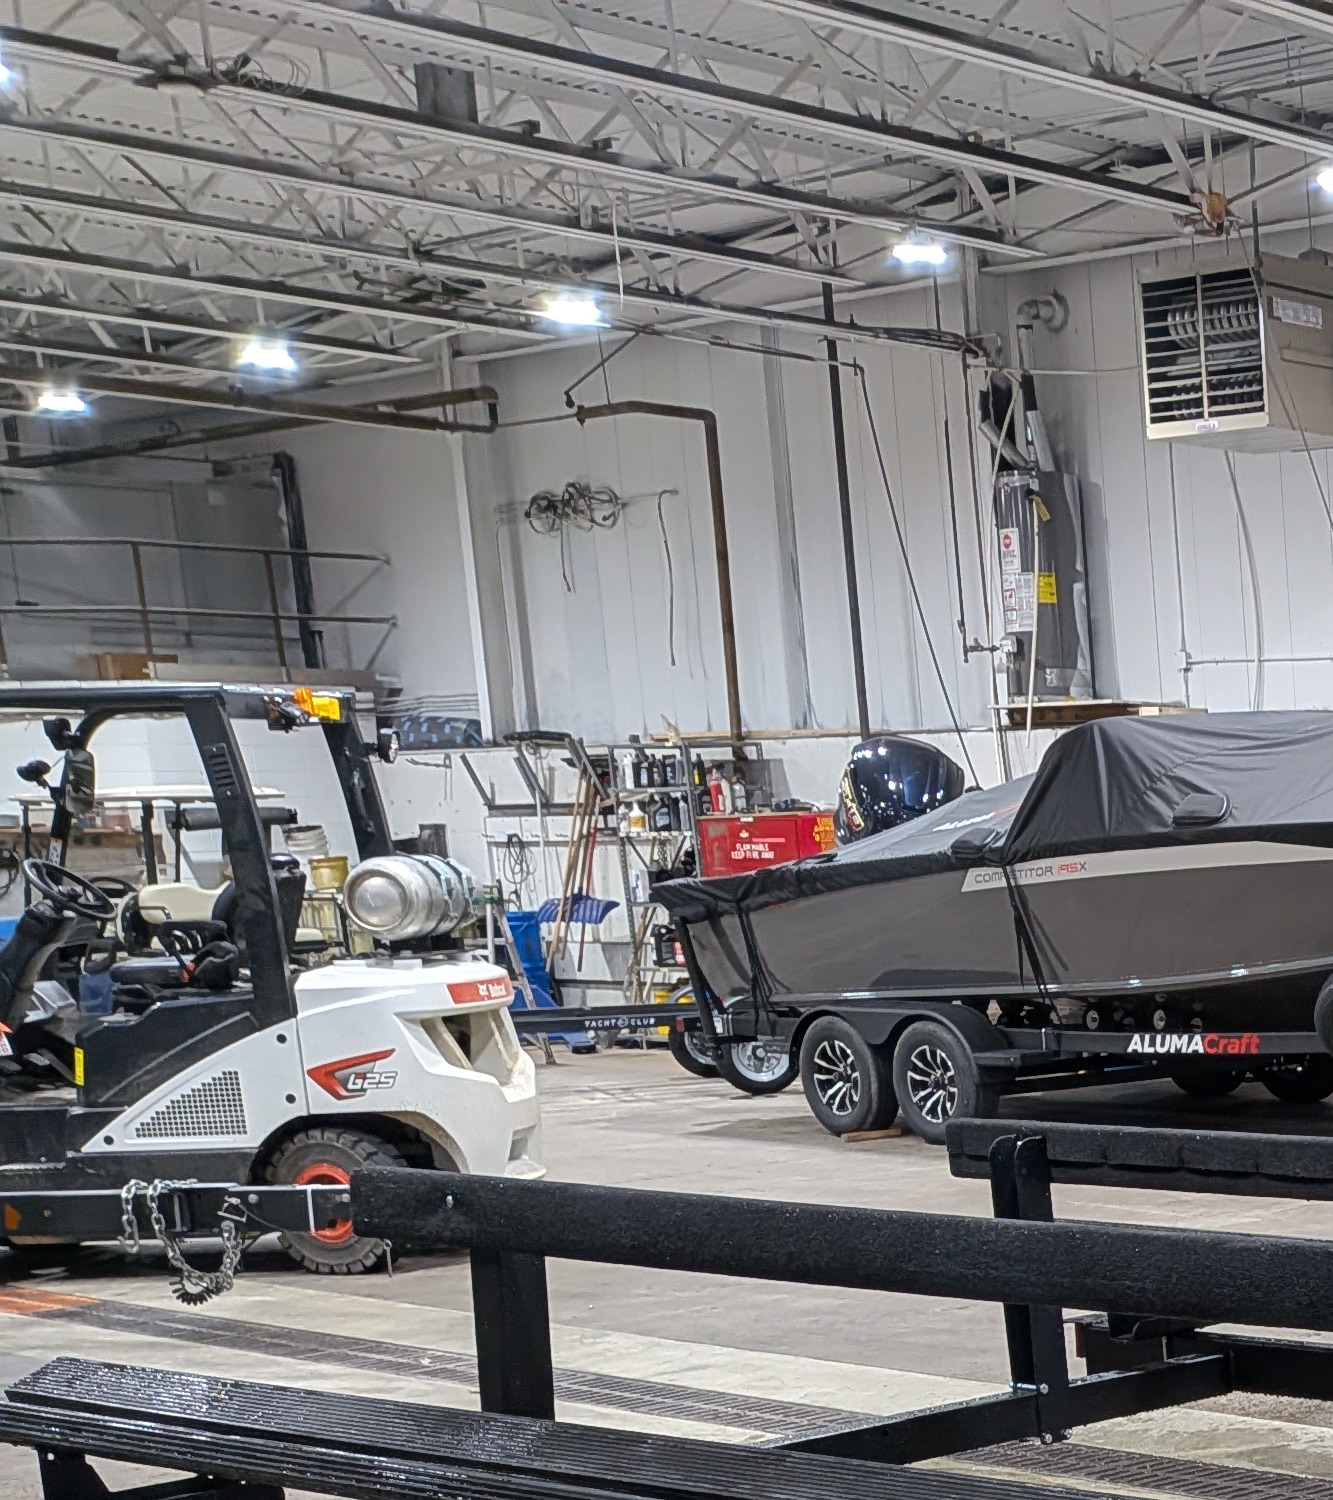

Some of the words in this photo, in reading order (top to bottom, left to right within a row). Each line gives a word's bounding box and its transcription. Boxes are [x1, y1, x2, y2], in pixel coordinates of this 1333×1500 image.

[584, 1018, 617, 1028] YACHT
[1126, 1032, 1261, 1054] ALUMACraft
[346, 1070, 398, 1091] G25
